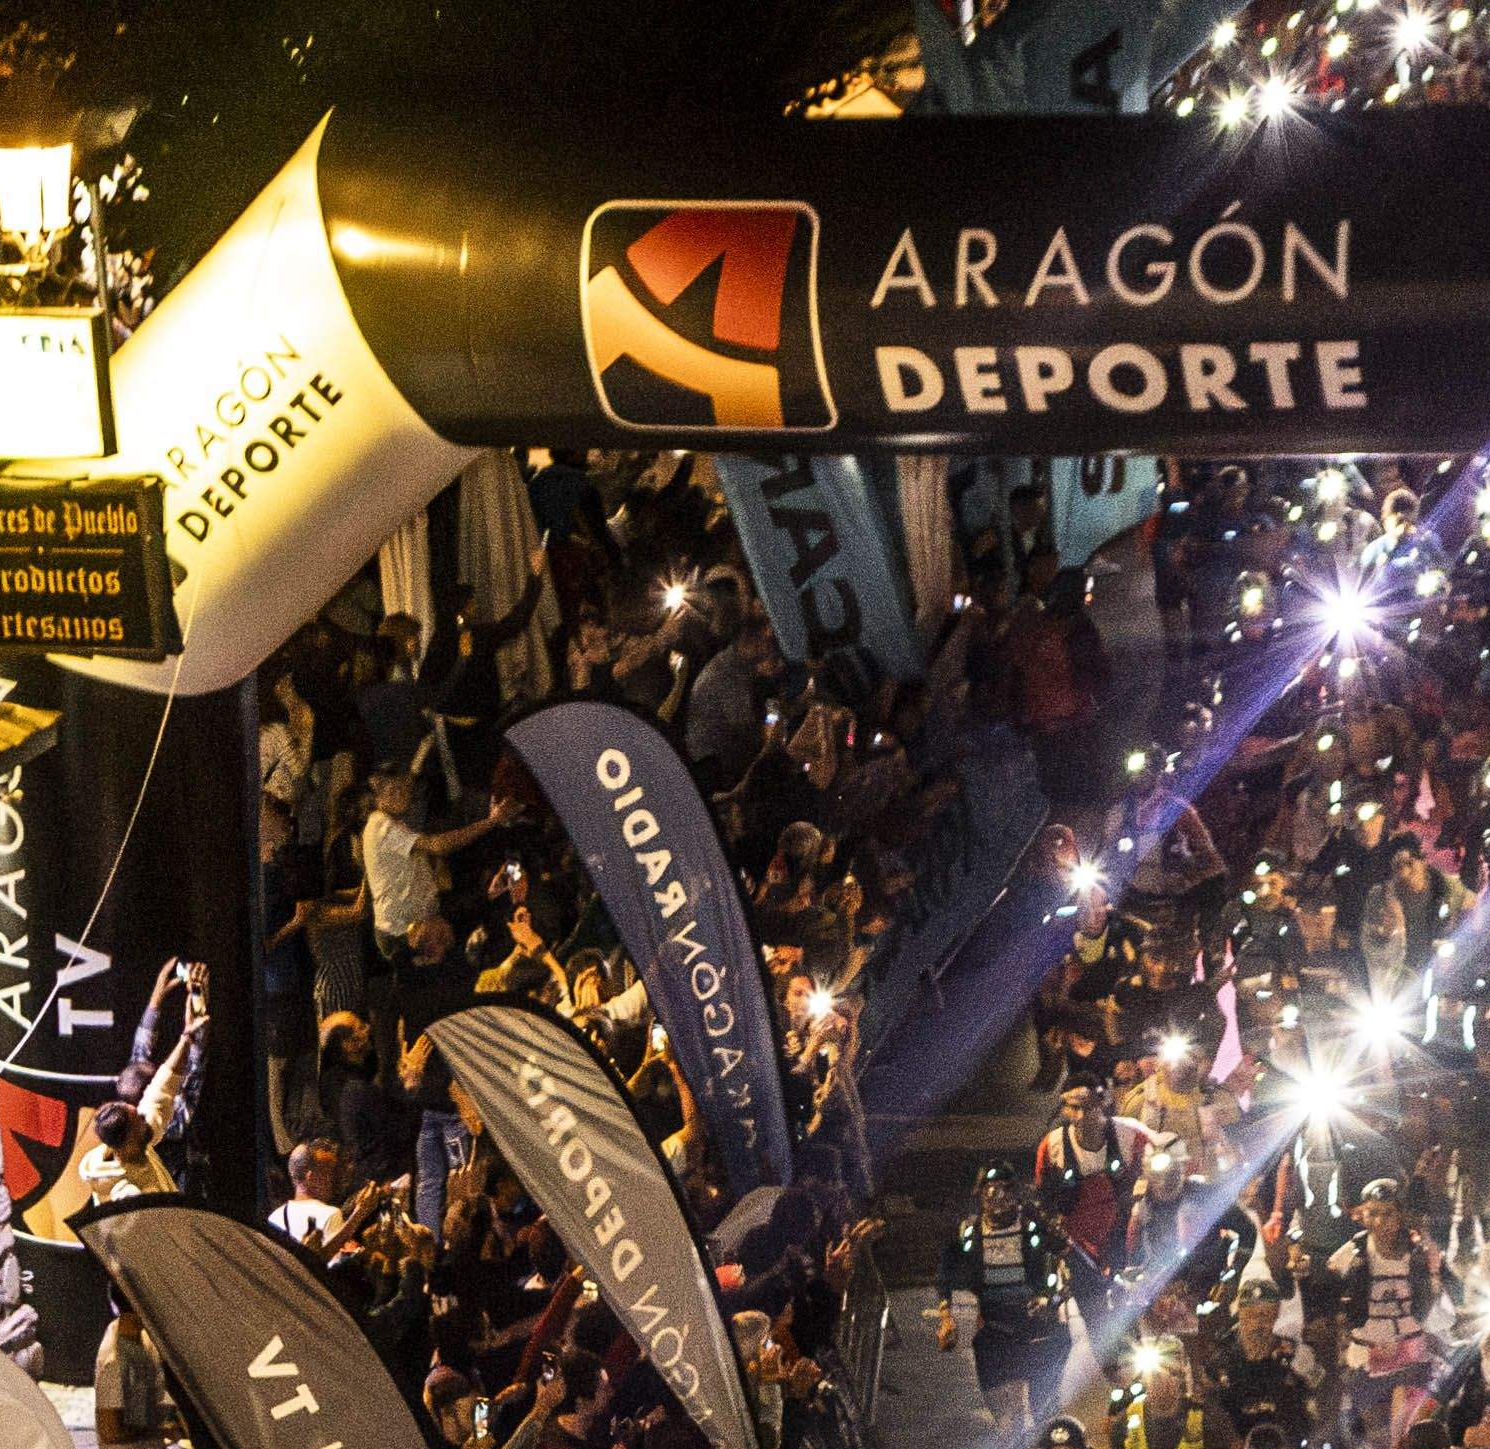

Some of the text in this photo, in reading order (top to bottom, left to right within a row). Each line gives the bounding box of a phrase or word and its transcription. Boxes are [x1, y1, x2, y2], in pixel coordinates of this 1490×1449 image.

[871, 200, 1353, 310] ARAGÓN
[162, 334, 302, 486] RAGÓN
[874, 339, 1369, 414] DEPORTE
[177, 373, 343, 542] DEPORTE
[33, 503, 56, 534] de
[62, 501, 138, 541] Pueblo
[55, 932, 114, 1037] TV
